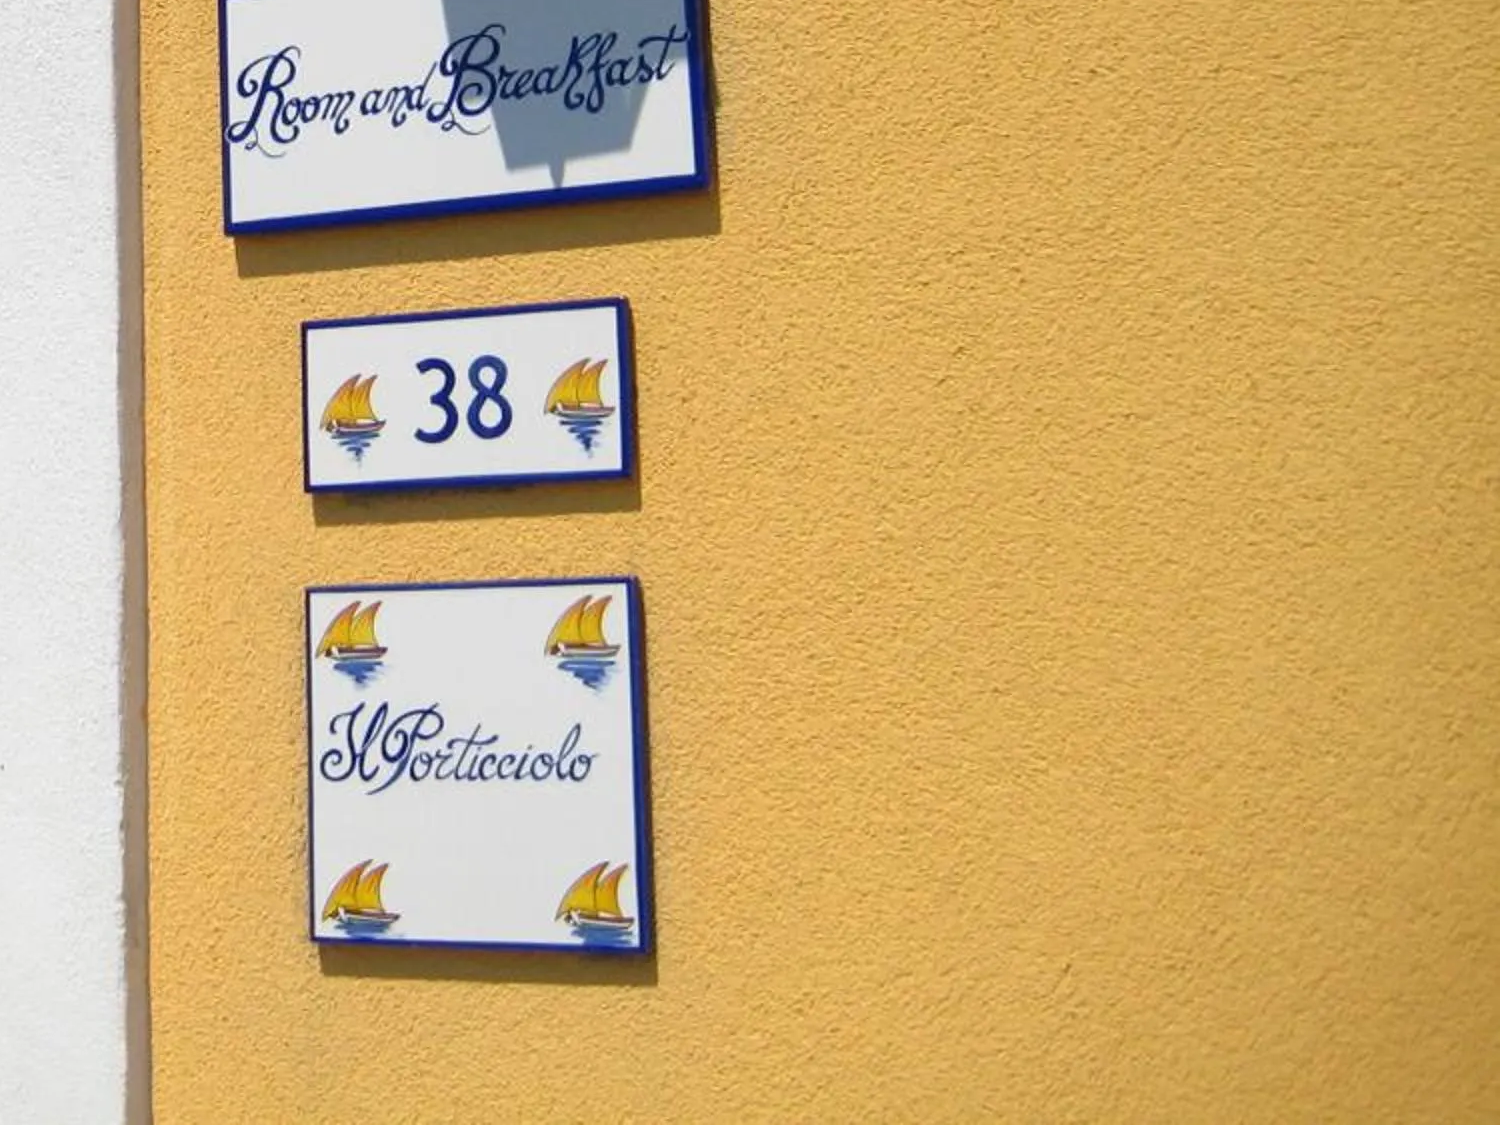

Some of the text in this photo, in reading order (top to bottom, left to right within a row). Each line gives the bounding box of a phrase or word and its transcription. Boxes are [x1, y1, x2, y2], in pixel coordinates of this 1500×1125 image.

[227, 23, 690, 158] Room and Breakfast
[414, 354, 512, 444] 38
[319, 701, 600, 796] Il Porticciolo
